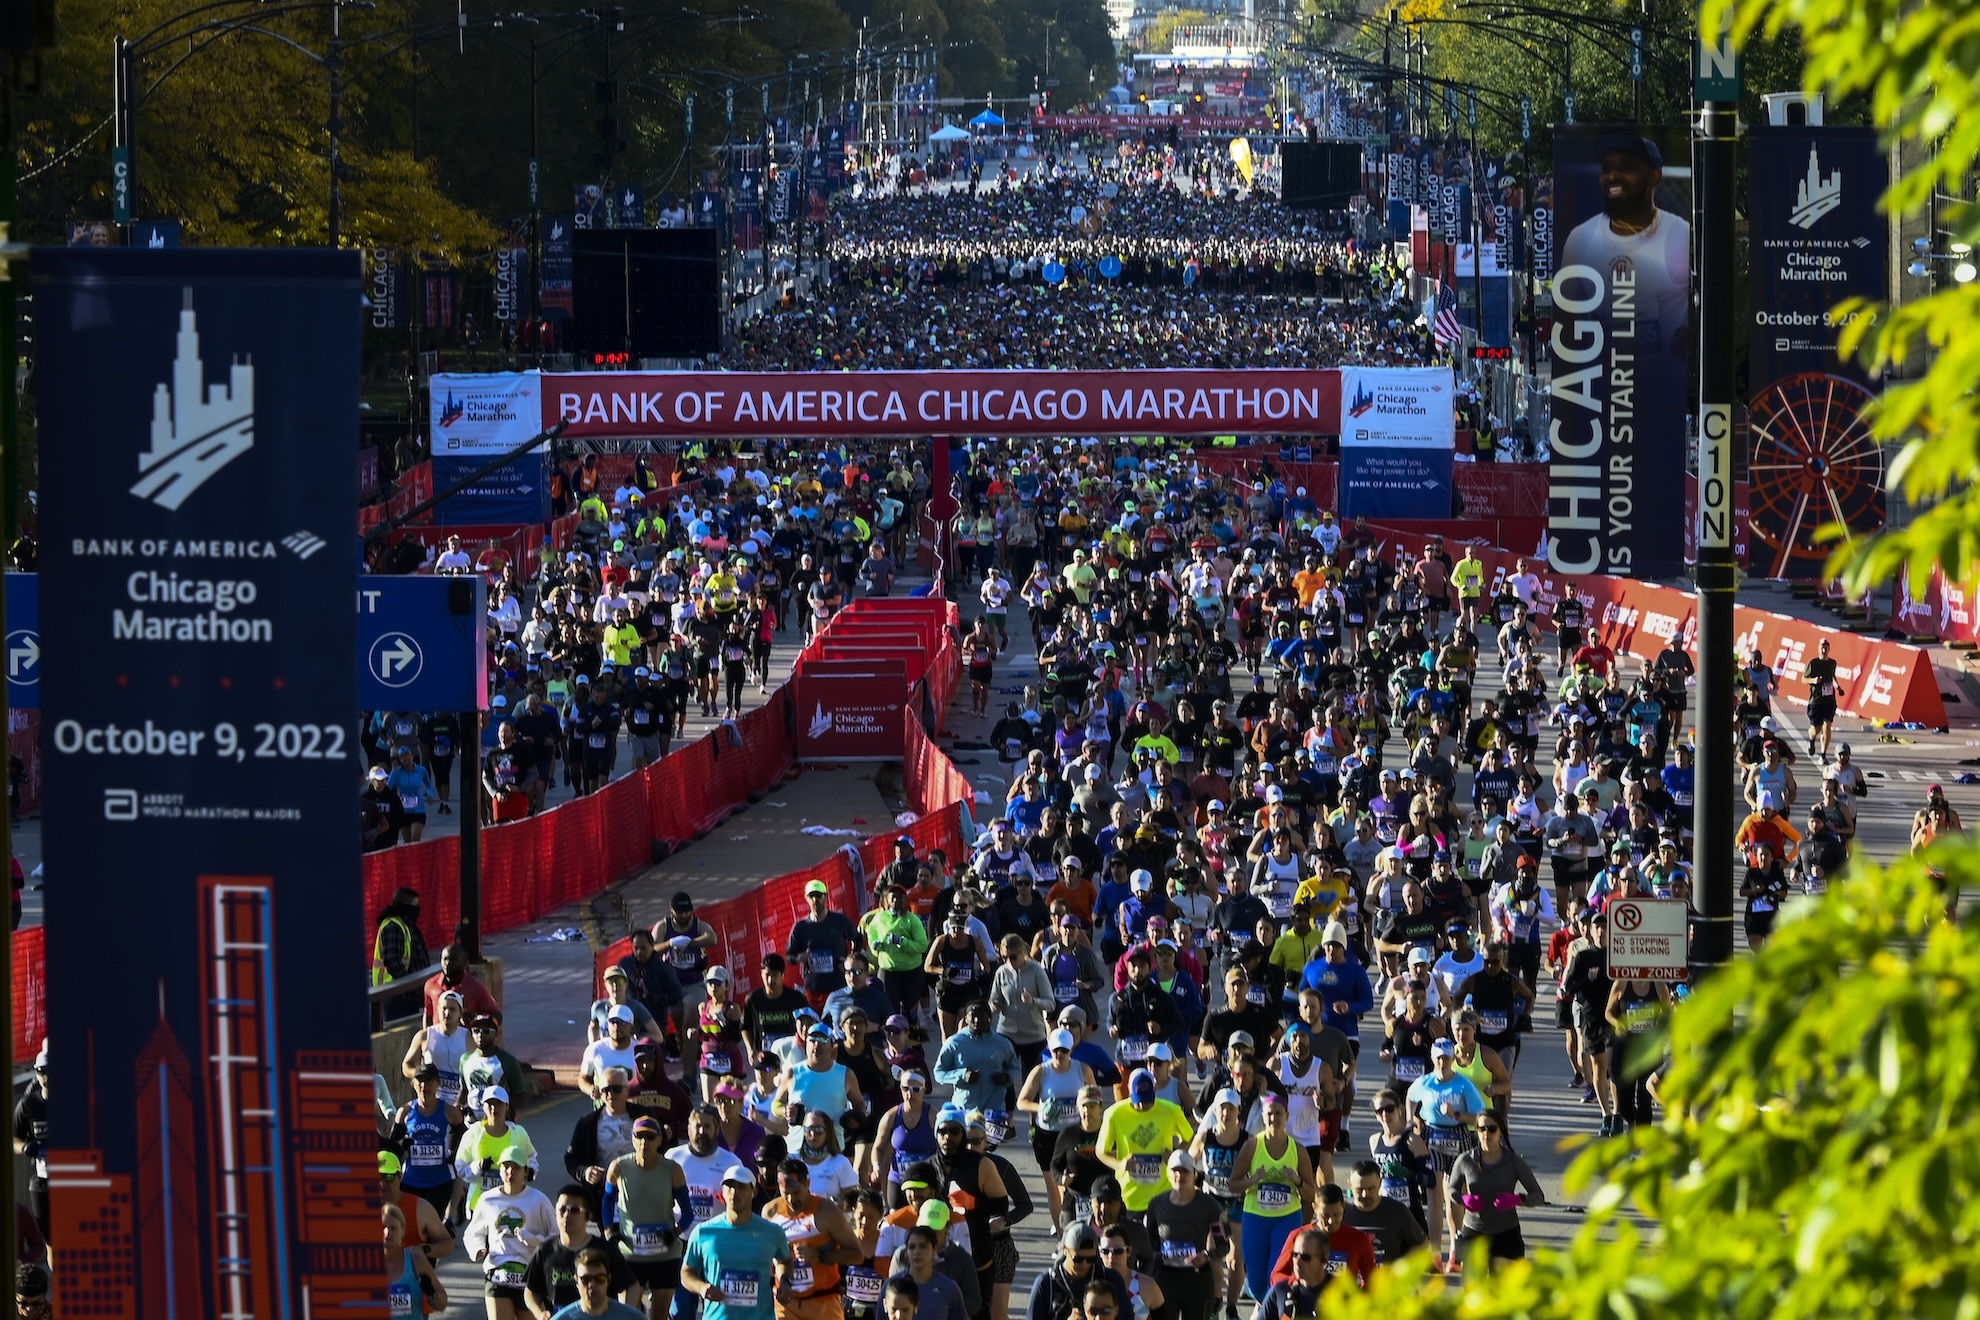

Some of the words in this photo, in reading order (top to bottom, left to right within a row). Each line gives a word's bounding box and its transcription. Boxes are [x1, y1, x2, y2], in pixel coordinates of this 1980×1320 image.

[1055, 117, 1068, 125] No
[1070, 118, 1100, 127] re-entry
[1127, 116, 1139, 124] No
[1141, 117, 1174, 126] re-entry
[1215, 118, 1246, 128] re-entry
[114, 161, 127, 209] C41
[1428, 174, 1439, 230] CHICAGO
[1084, 216, 1093, 228] K
[1443, 185, 1456, 246] CHICAGO
[1494, 205, 1507, 271] CHICAGO
[1534, 207, 1547, 280] CHICAGO
[1763, 240, 1791, 248] BANK
[1792, 240, 1804, 248] OF
[1806, 240, 1851, 248] AMERICA
[1786, 252, 1841, 269] Chicago
[1780, 268, 1848, 281] Marathon
[373, 248, 387, 328] CHICAGO
[1611, 269, 1636, 338] LINE
[1755, 311, 1820, 325] October
[1377, 394, 1417, 406] Chicago
[1609, 348, 1635, 444] START
[467, 401, 507, 414] Chicago
[559, 391, 665, 424] BANK
[674, 391, 725, 423] OF
[733, 389, 908, 423] AMERICA
[917, 389, 1088, 422] CHICAGO
[1101, 387, 1320, 420] MARATHON
[1376, 405, 1426, 415] Marathon
[467, 412, 517, 422] Marathon
[1548, 264, 1605, 575] CHICAGO
[1366, 458, 1384, 466] What
[1386, 458, 1408, 466] would
[459, 466, 475, 474] What
[502, 467, 515, 475] you
[509, 473, 523, 481] do?
[1356, 466, 1369, 475] like
[1371, 466, 1383, 475] the
[1384, 468, 1406, 477] power
[1417, 468, 1430, 476] do?
[467, 488, 478, 496] OF
[479, 488, 515, 496] AMERICA
[1608, 455, 1633, 537] YOUR
[1464, 505, 1495, 514] arathon
[72, 539, 135, 556] BANK
[140, 539, 170, 557] OF
[173, 541, 278, 558] AMERICA
[1608, 546, 1633, 574] IS
[127, 570, 257, 612] Chicago
[112, 608, 273, 642] Marathon
[835, 714, 875, 725] Chicago
[835, 724, 884, 733] Marathon
[53, 719, 206, 757] October
[213, 722, 247, 764] 9,
[253, 723, 347, 760] 2022
[141, 794, 184, 805] ABBOTT
[141, 805, 182, 818] WORLD
[183, 807, 250, 820] MARATHON
[253, 809, 302, 821] MAJORS
[1613, 938, 1625, 946] NO
[1630, 938, 1669, 946] STOPPING
[1613, 947, 1625, 955] NO
[1630, 947, 1670, 955] STANDING
[1614, 967, 1640, 978] TOW
[1647, 967, 1681, 978] ZONE
[411, 1123, 440, 1134] BOSTON
[412, 1144, 418, 1156] H
[418, 1144, 441, 1156] 31326
[1260, 1190, 1266, 1201] H
[636, 1233, 641, 1246] H
[723, 1280, 729, 1293] H
[731, 1280, 756, 1294] 31723
[847, 1276, 853, 1288] H
[855, 1277, 881, 1290] 30425
